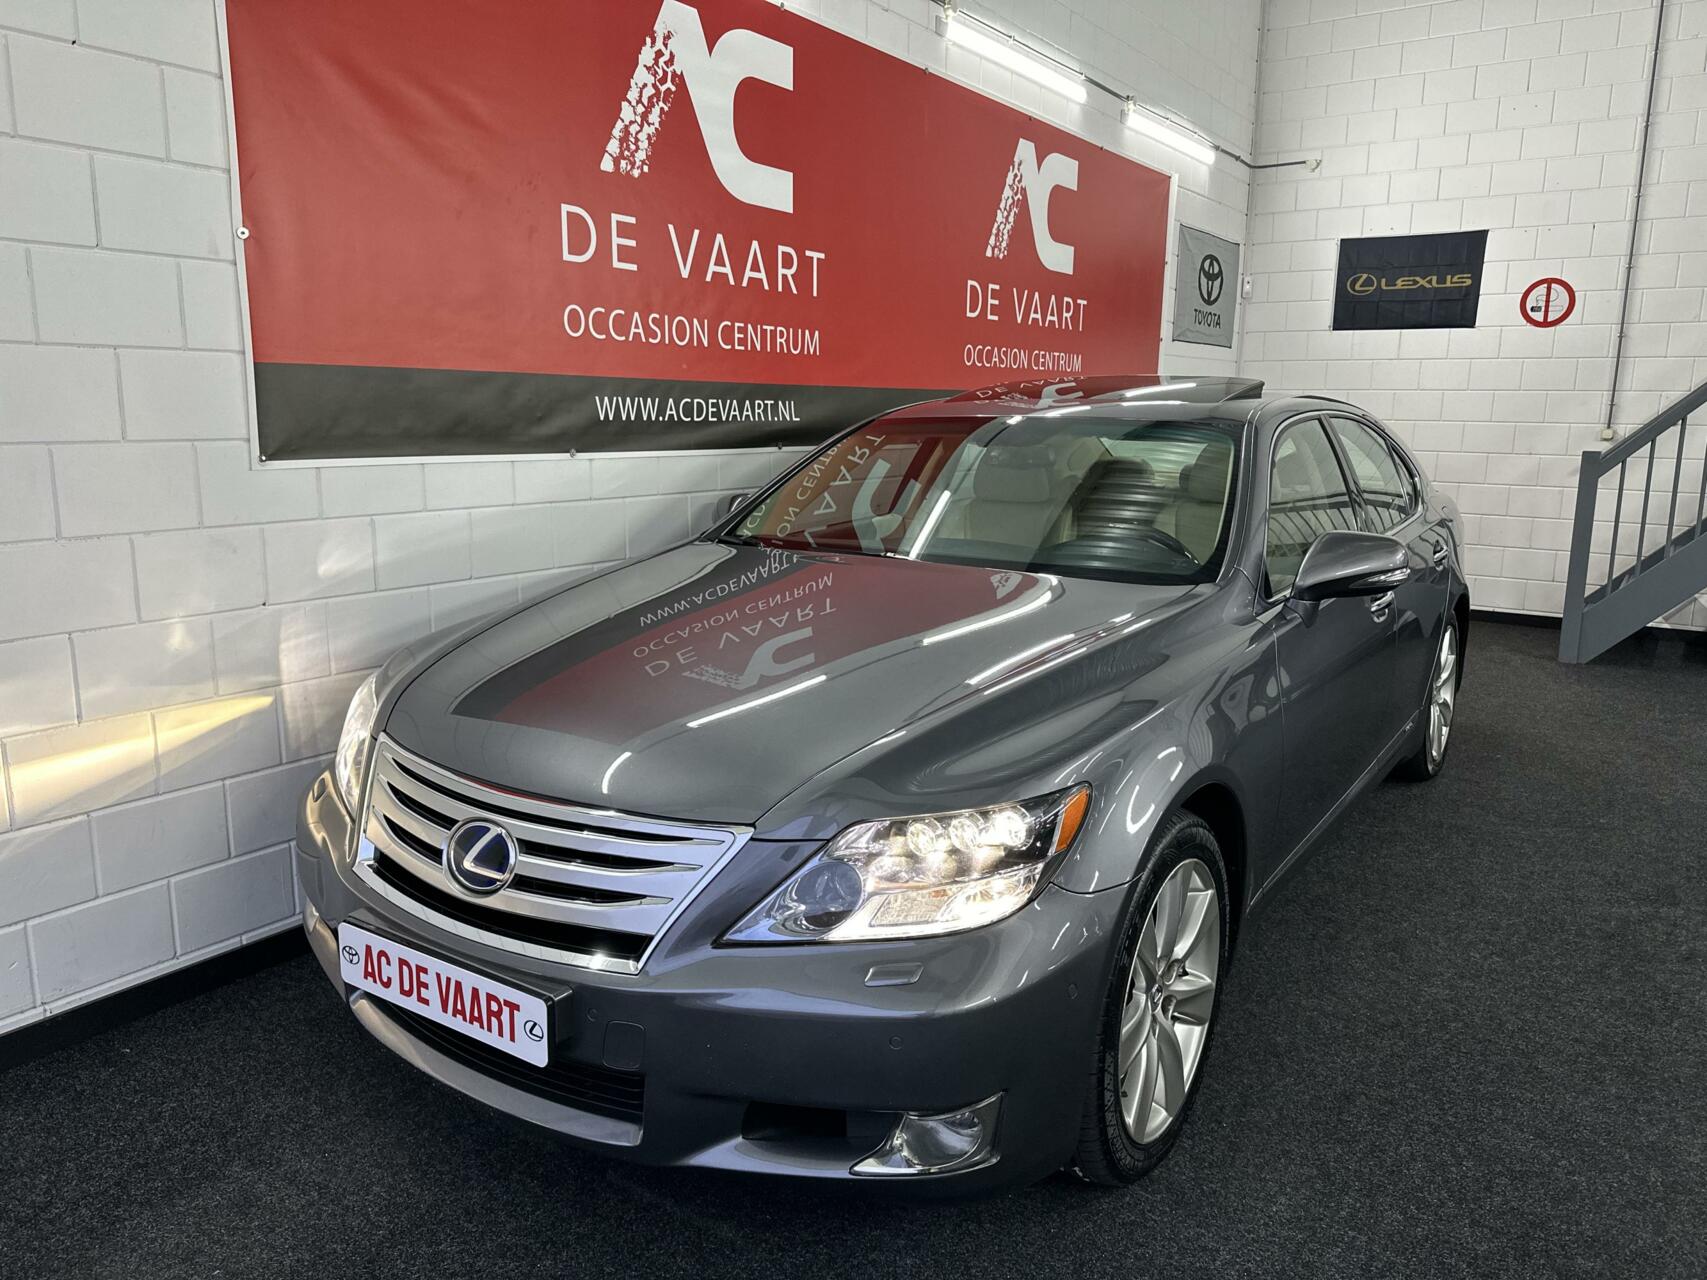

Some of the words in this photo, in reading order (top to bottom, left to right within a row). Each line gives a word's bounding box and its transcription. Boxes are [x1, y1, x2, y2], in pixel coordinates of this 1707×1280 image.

[560, 202, 638, 272] DE
[667, 223, 826, 297] VAART
[1380, 273, 1473, 290] LEXUS
[965, 279, 1000, 321] DE
[1012, 287, 1088, 332] VAART
[1193, 308, 1221, 329] TOYOTA
[563, 303, 709, 348] OCCASION
[717, 320, 820, 356] CENTRUM
[963, 343, 1029, 369] OCCASION
[1031, 350, 1082, 373] CENTRUM
[594, 395, 801, 422] WWW.ACDEVAART.NL
[362, 943, 392, 990] AC
[397, 956, 430, 1007] DE
[435, 971, 521, 1044] VAART
